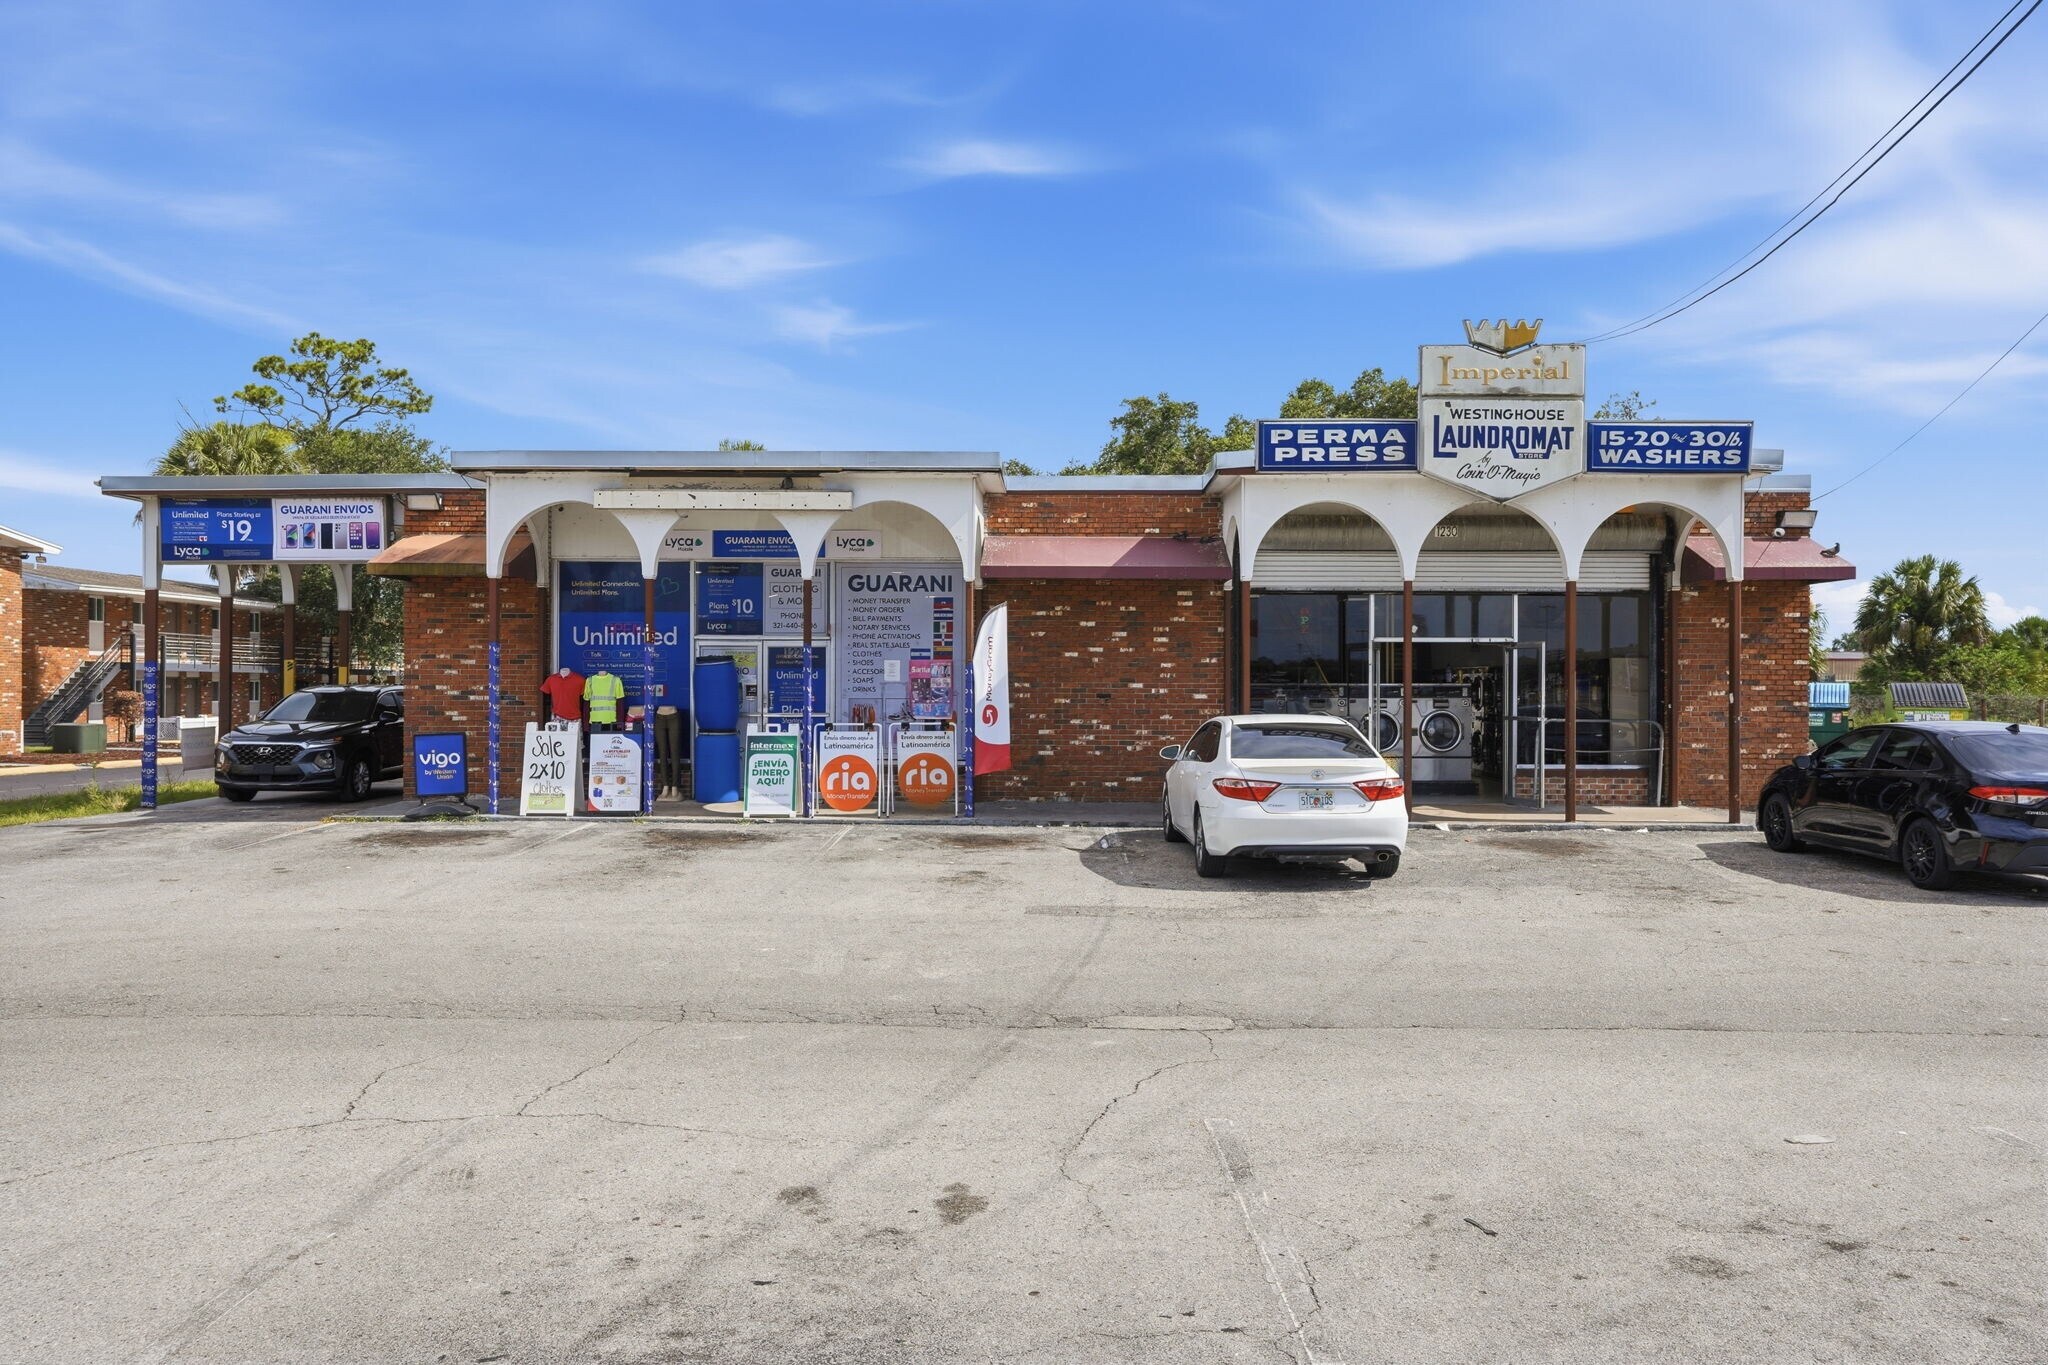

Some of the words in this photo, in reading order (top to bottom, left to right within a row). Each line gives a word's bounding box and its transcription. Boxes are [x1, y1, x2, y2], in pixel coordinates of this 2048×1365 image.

[1437, 355, 1571, 386] Imperial
[1450, 409, 1565, 421] WESTINGHOUSE
[1270, 429, 1407, 444] PERMA
[1433, 415, 1574, 460] LAUNDROMAT
[1600, 430, 1670, 447] 15-20
[1275, 446, 1405, 462] PRESS
[1479, 450, 1492, 465] by
[1599, 449, 1741, 465] WASHERS
[172, 510, 209, 519] Unlimited
[281, 505, 331, 514] GUARANI
[334, 505, 374, 514] ENVIOS
[221, 520, 252, 542] $19
[665, 537, 694, 547] Lyca
[725, 536, 765, 545] GUARANI
[768, 536, 794, 545] ENVIO
[836, 536, 865, 547] Lyca
[174, 545, 201, 557] Lyca
[772, 585, 819, 593] CLOTHG
[848, 574, 953, 592] GUARANI
[709, 602, 729, 610] Plans
[732, 599, 753, 614] $10
[707, 622, 726, 630] Lyca
[532, 735, 565, 758] Sale
[750, 741, 794, 749] intermex
[824, 742, 874, 750] Latinoamérica
[419, 749, 461, 768] vigo
[754, 758, 788, 768] ¡ENVÍA
[752, 769, 790, 777] DINERO
[826, 761, 870, 790] ria
[905, 759, 948, 785] ria
[756, 777, 785, 786] AQUÍ!
